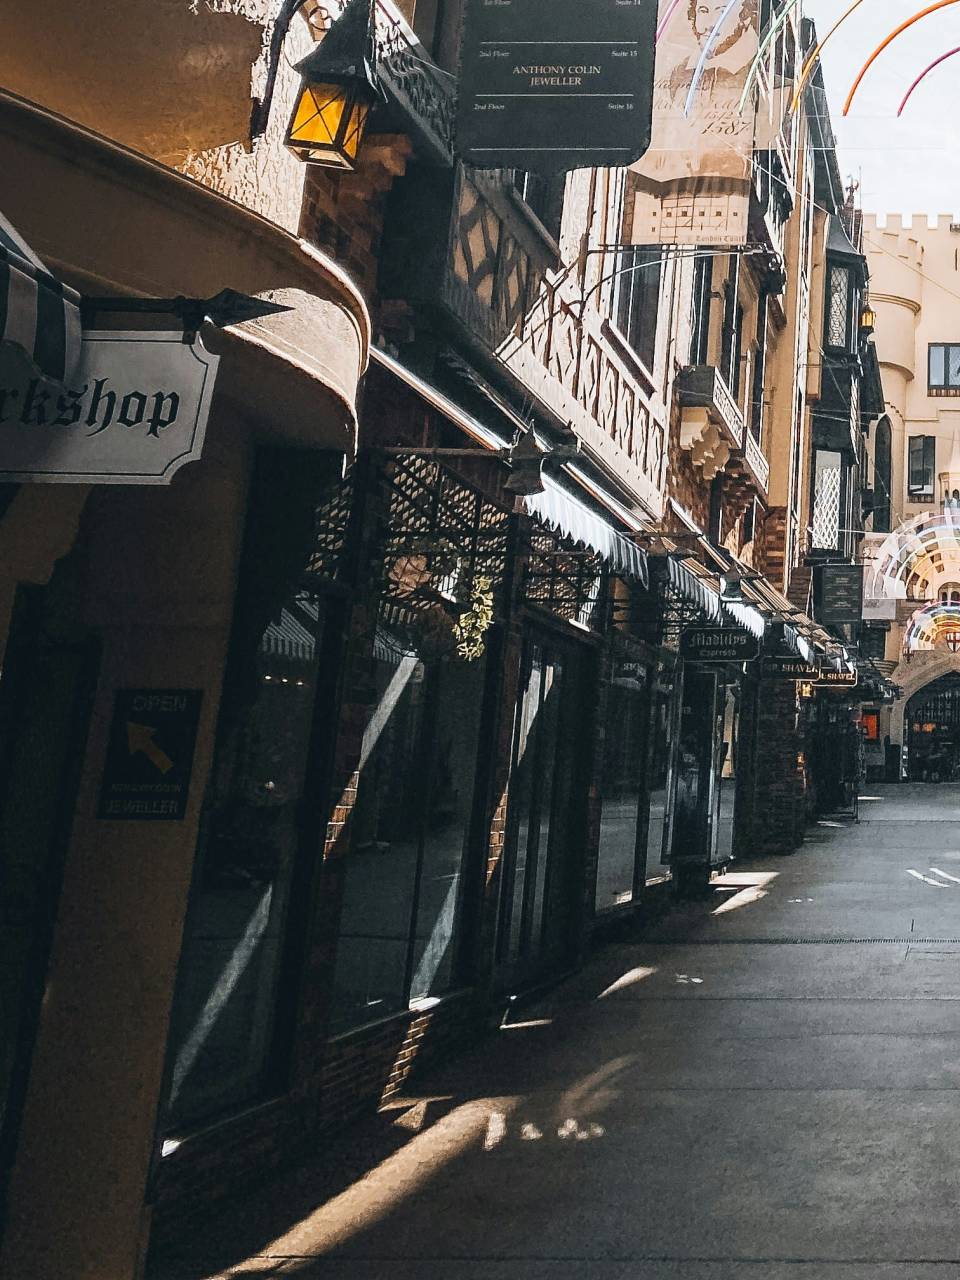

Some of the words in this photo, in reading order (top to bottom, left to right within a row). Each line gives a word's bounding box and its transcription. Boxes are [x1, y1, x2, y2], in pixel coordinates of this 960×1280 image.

[512, 65, 567, 75] ANTHONY
[568, 65, 602, 75] COLIN
[530, 76, 582, 86] JEWELLER
[782, 663, 819, 673] SHAVER
[131, 695, 187, 712] OPEN
[105, 799, 179, 815] JEWELLER
